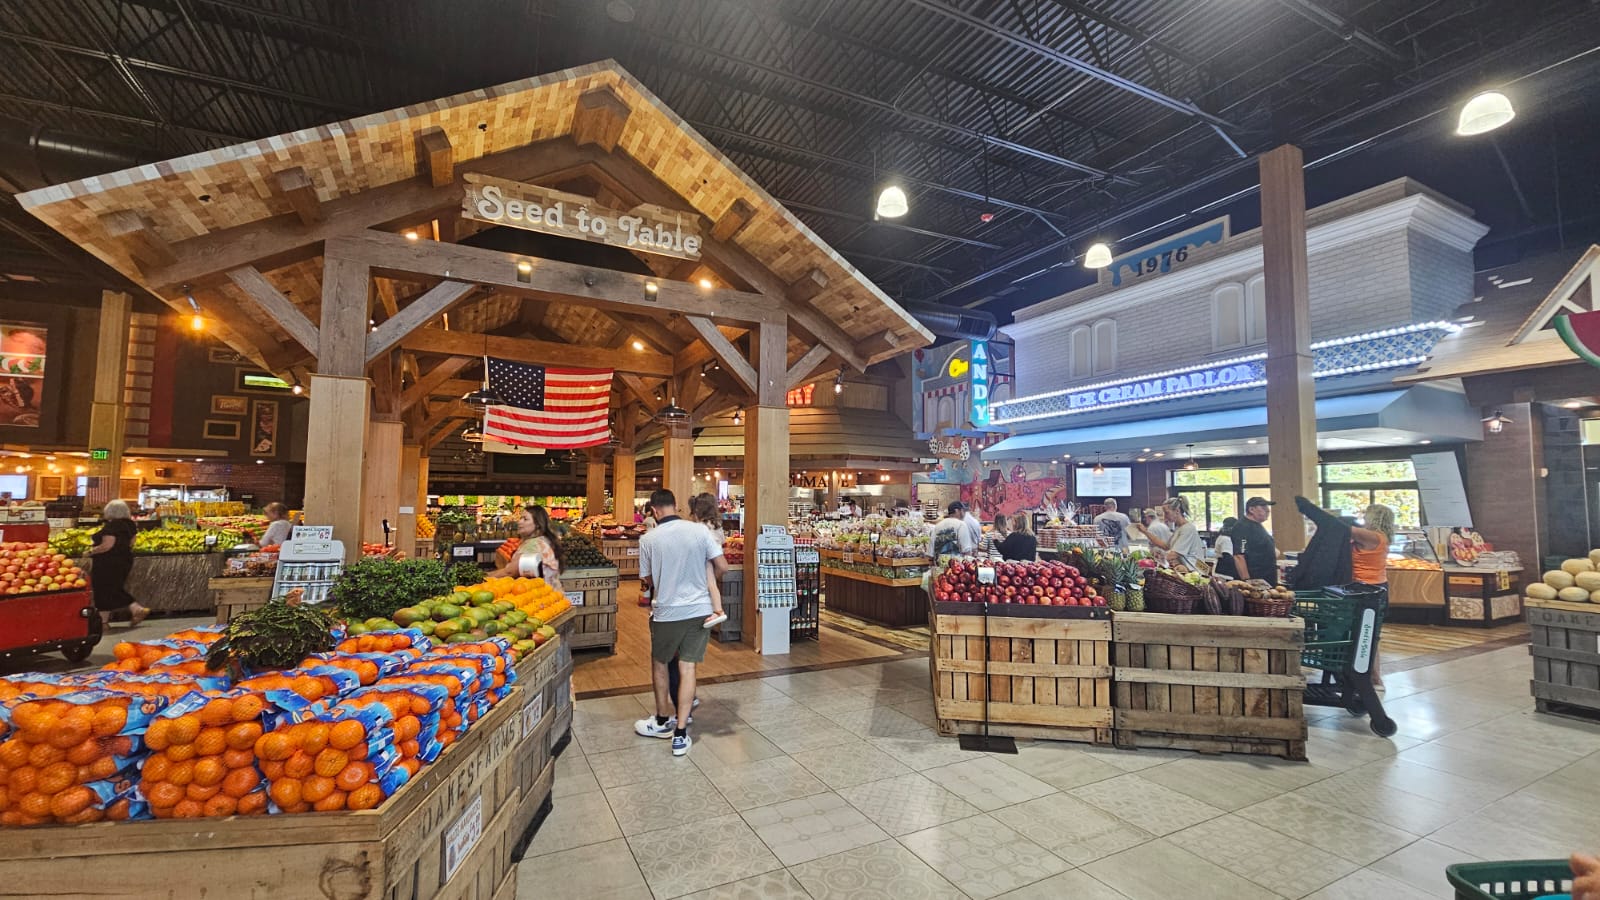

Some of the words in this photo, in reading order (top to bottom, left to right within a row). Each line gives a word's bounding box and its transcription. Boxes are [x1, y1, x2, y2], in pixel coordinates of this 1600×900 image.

[477, 185, 564, 227] Seed
[576, 204, 607, 235] to
[618, 213, 700, 254] Table
[1136, 246, 1189, 277] 1976
[786, 384, 816, 406] RY
[973, 343, 988, 421] ANDY
[1069, 393, 1097, 408] ICE
[1098, 379, 1163, 403] CREAM
[1166, 364, 1255, 393] PARLOR
[92, 450, 108, 460] EXIT
[575, 579, 610, 589] FARMS
[1542, 612, 1597, 626] OAKE
[476, 720, 515, 771] FARMS
